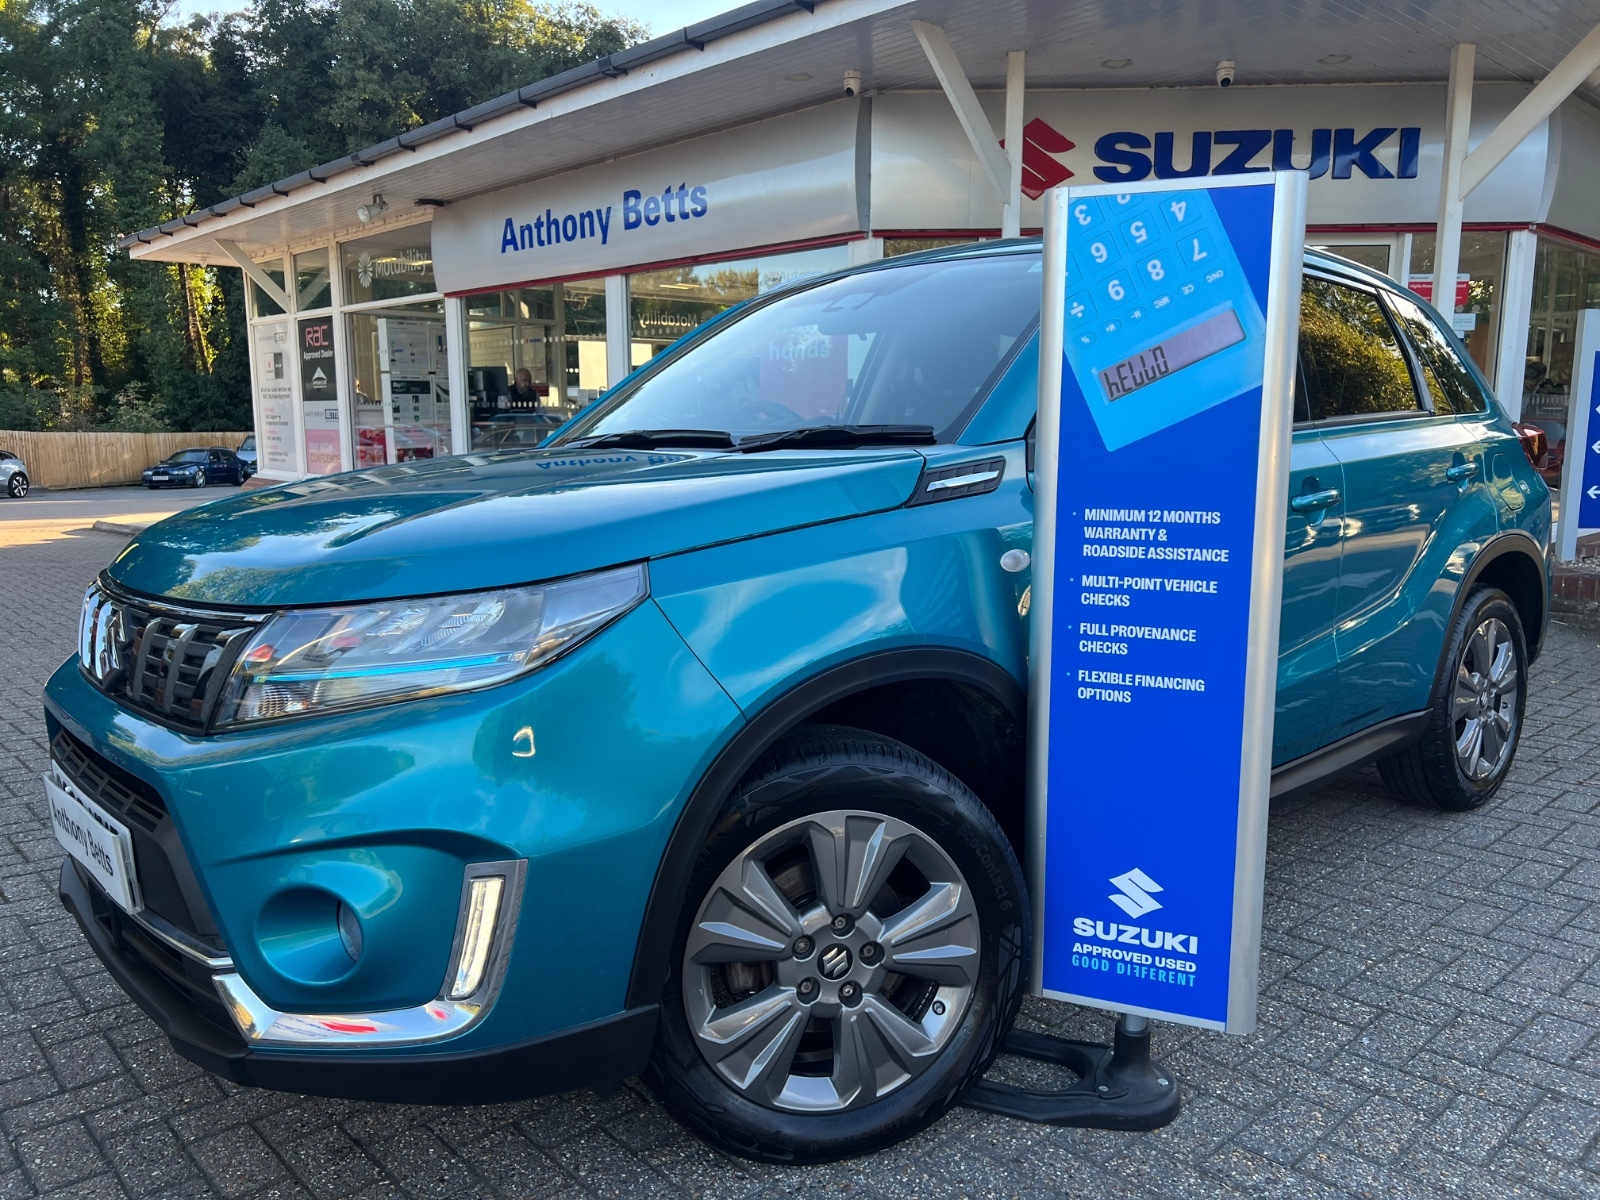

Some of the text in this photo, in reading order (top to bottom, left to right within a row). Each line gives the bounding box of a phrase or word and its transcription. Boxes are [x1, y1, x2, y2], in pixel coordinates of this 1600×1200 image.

[1093, 127, 1421, 183] SUZUKI
[501, 182, 708, 254] Anthony Betts
[1074, 205, 1092, 225] 3
[1170, 201, 1187, 222] 4
[1130, 221, 1148, 244] 5
[1192, 238, 1208, 262] 7
[375, 249, 427, 278] Motability
[1147, 259, 1165, 281] 8
[1206, 269, 1224, 283] ON/C
[1182, 284, 1194, 295] CE
[1153, 296, 1170, 308] MRC
[306, 325, 329, 347] RAC
[303, 349, 334, 361] Approved Dealer
[768, 340, 831, 360] hands
[1084, 508, 1221, 524] MINIMUM 12 MONTHS
[1083, 526, 1168, 541] WARRANTY &
[1083, 544, 1229, 562] ROADSIDE ASSISTANCE
[1081, 575, 1218, 593] MULTI-POINT VEHICLE
[1081, 592, 1130, 607] CHECKS
[1079, 622, 1197, 642] FULL PROVENANCE
[1079, 640, 1128, 655] CHECKS
[1078, 669, 1205, 691] FLEXIBLE FINANCING
[1077, 686, 1132, 703] OPTIONS
[52, 798, 89, 856] Anthony
[87, 828, 114, 877] Betts
[1072, 917, 1198, 955] SUZUKI
[1072, 942, 1197, 973] APPROVED USED
[1071, 954, 1196, 987] GOOD DIFFERENT
